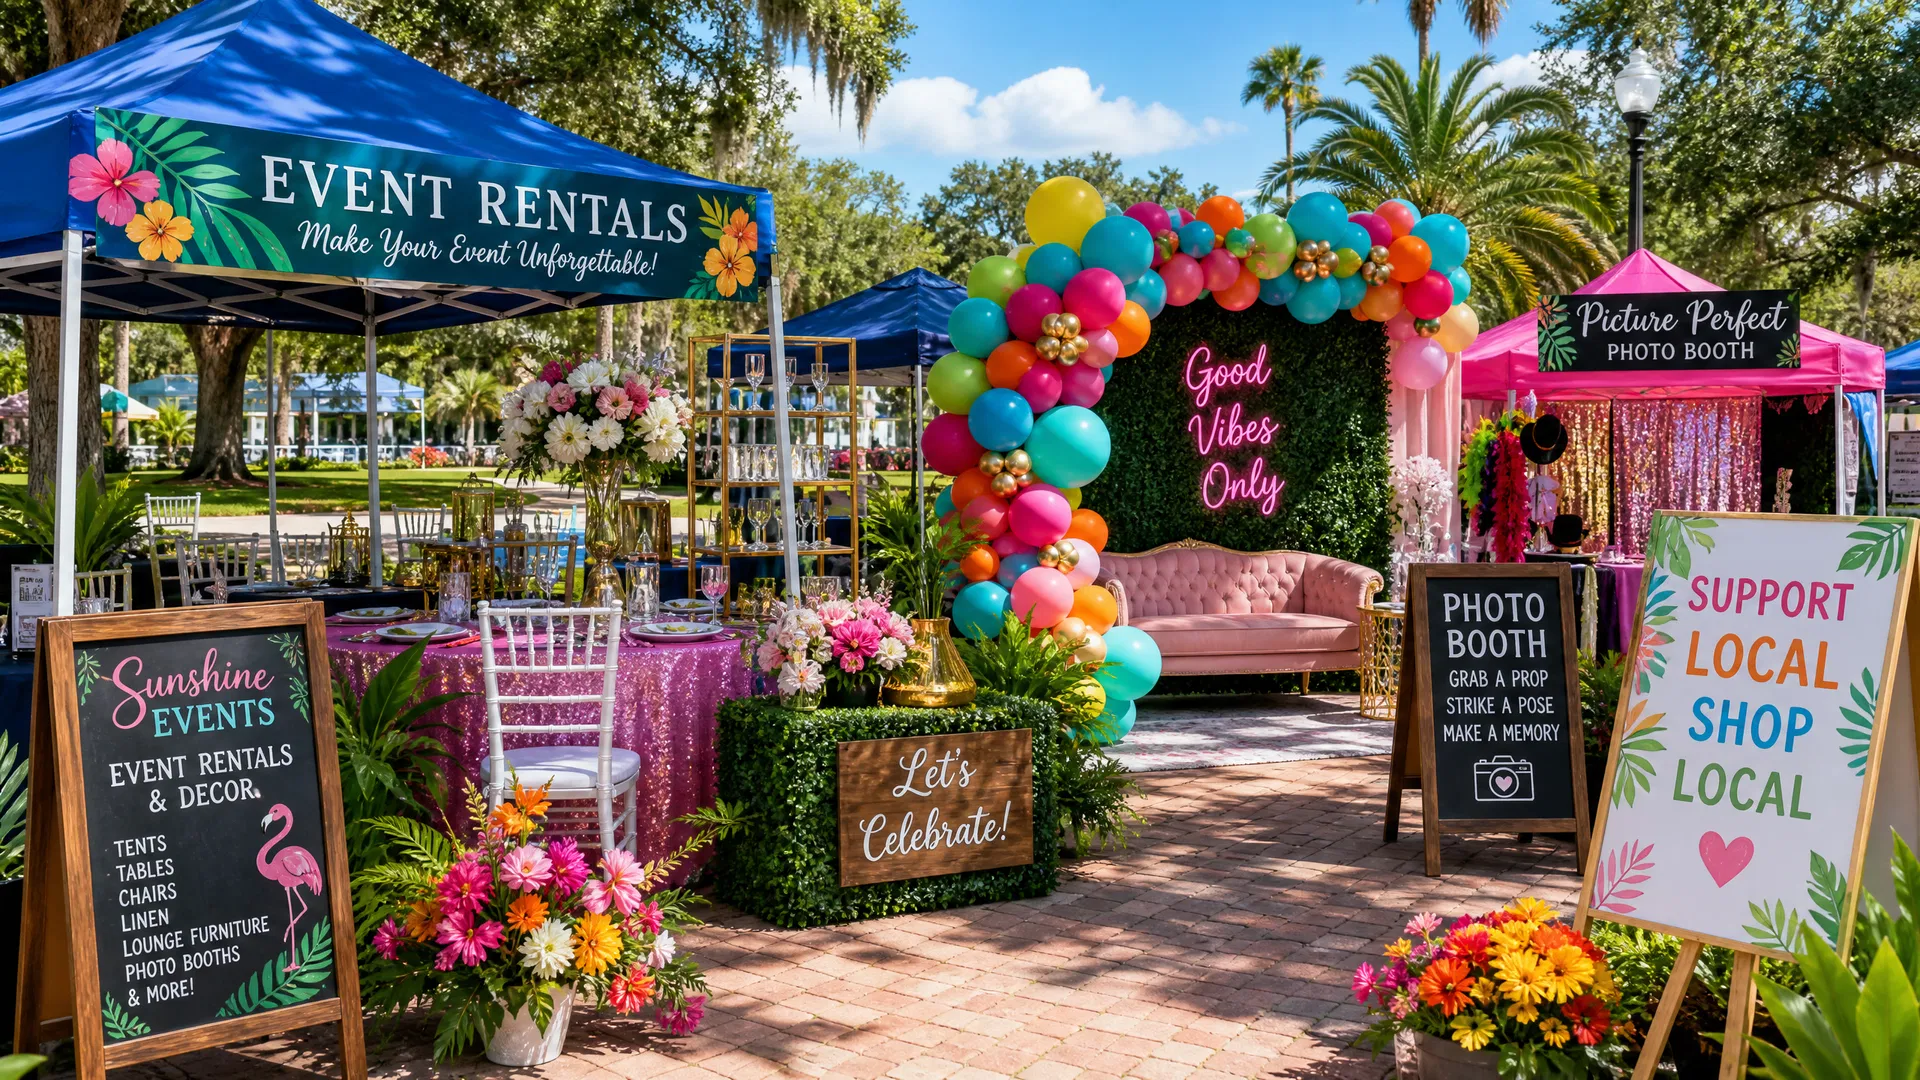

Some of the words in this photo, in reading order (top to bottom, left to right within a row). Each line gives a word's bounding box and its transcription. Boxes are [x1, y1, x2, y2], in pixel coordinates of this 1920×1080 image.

[261, 155, 452, 220] EVENT
[478, 181, 688, 244] RENTALS
[297, 220, 374, 254] Make
[379, 229, 442, 268] Your
[449, 234, 512, 266] Event
[516, 240, 658, 282] Unforgettable!
[1576, 301, 1678, 337] Picture
[1686, 299, 1789, 340] Perfect
[1607, 343, 1676, 360] PHOTO
[1684, 342, 1754, 360] BOOTH
[1186, 344, 1272, 407] Good
[1188, 403, 1279, 455] Vibes
[1203, 457, 1285, 515] Only
[1443, 592, 1545, 623] PHOTO
[1688, 575, 1854, 621] SUPPORT
[1447, 629, 1547, 658] BOOTH
[1685, 630, 1839, 690] LOCAL
[112, 648, 275, 729] Sunshine
[1449, 670, 1488, 688] GRAB
[1495, 669, 1505, 688] A
[1511, 670, 1549, 688] PROP
[151, 697, 275, 738] EVENTS
[1446, 696, 1495, 715] STRIKE
[1501, 696, 1512, 714] A
[1518, 696, 1554, 714] POSE
[1688, 696, 1813, 753] SHOP
[1443, 724, 1482, 742] MAKE
[1488, 724, 1498, 741] A
[1503, 723, 1560, 742] MEMORY
[109, 755, 187, 787] EVENT
[198, 744, 293, 776] RENTALS
[892, 748, 977, 798] Let's
[149, 789, 167, 813] &
[1672, 758, 1812, 820] LOCAL
[114, 834, 167, 858] TENTS
[859, 800, 1012, 862] Celebrate!
[116, 858, 174, 882] TABLES
[119, 883, 177, 907] CHAIRS
[121, 908, 169, 932] LINEN
[123, 930, 184, 957] LOUNGE
[190, 915, 270, 946] FURNITURE
[125, 956, 176, 982] PHOTO
[183, 945, 240, 972] BOOTHS
[127, 988, 140, 1007] &
[147, 977, 194, 1004] MORE!
